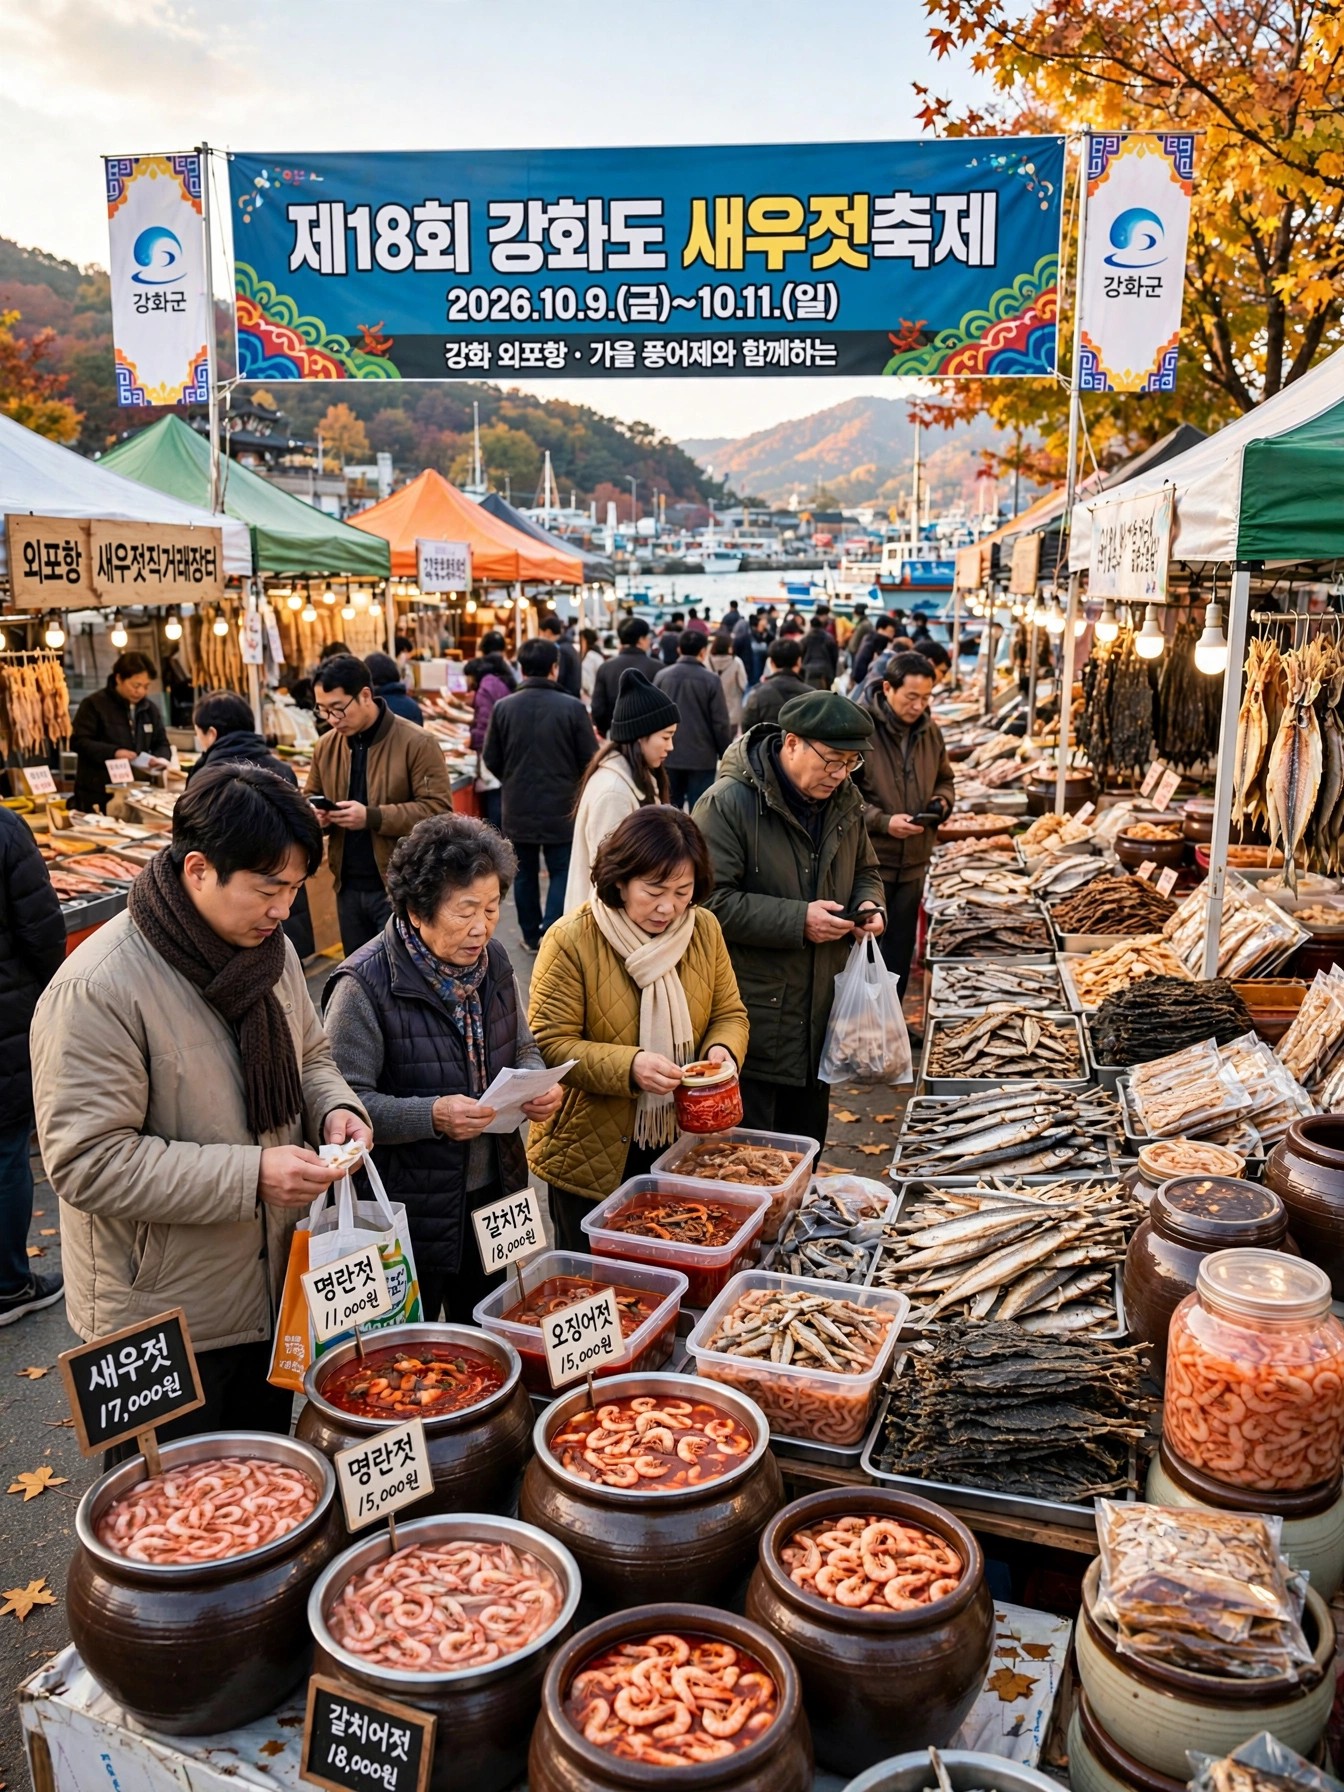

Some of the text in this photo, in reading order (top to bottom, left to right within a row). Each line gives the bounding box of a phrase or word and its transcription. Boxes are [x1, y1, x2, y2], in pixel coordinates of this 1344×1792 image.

[288, 191, 998, 274] 제18회 강화도 새우젓축제
[132, 291, 187, 314] 강화군
[447, 282, 840, 323] 2026.10.9.(금)~10.11.(일)
[1103, 275, 1164, 299] 강화군
[445, 341, 492, 370] 강화
[497, 340, 568, 369] 외포항
[589, 339, 636, 368] 가을
[642, 338, 737, 368] 풍어제와
[742, 337, 838, 367] 함께하는
[23, 539, 218, 584] 외포항 새우젓직거래장터
[482, 1197, 533, 1239] 갈치젓
[491, 1228, 537, 1263] 18,000원
[313, 1255, 376, 1302] 명란젓
[325, 1289, 380, 1330] 11,000원
[552, 1299, 614, 1349] 오징어젓
[89, 1332, 172, 1391] 새우젓
[561, 1334, 614, 1375] 15,000원
[100, 1372, 183, 1429] 17,000원
[348, 1432, 416, 1485] 명란젓
[359, 1469, 420, 1517] 15,000원
[329, 1703, 411, 1762] 갈치어젓
[327, 1743, 398, 1791] 18,000원
